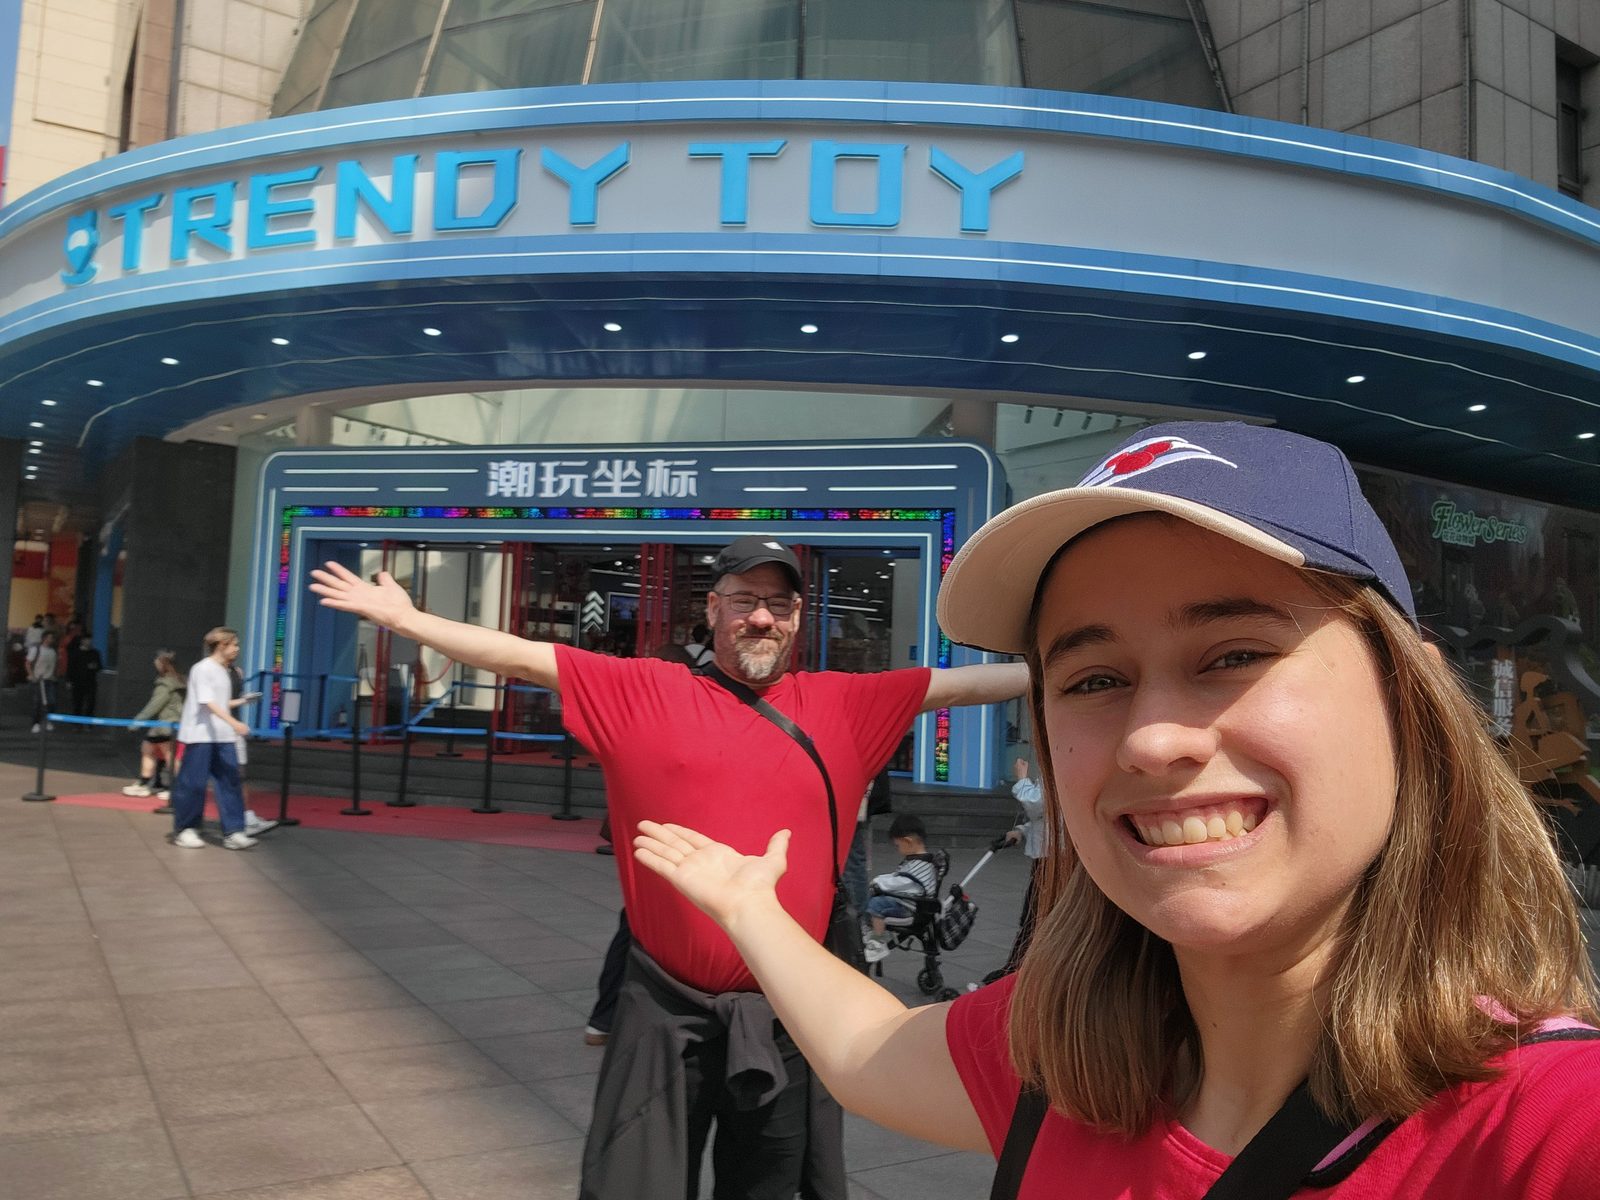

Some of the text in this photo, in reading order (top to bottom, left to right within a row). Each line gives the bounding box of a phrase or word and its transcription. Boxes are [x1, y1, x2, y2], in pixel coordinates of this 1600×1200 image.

[109, 139, 1025, 272] TRENDY TOY
[486, 459, 698, 498] 潮玩坐标
[1432, 500, 1486, 539] Flower
[1483, 516, 1528, 544] Series
